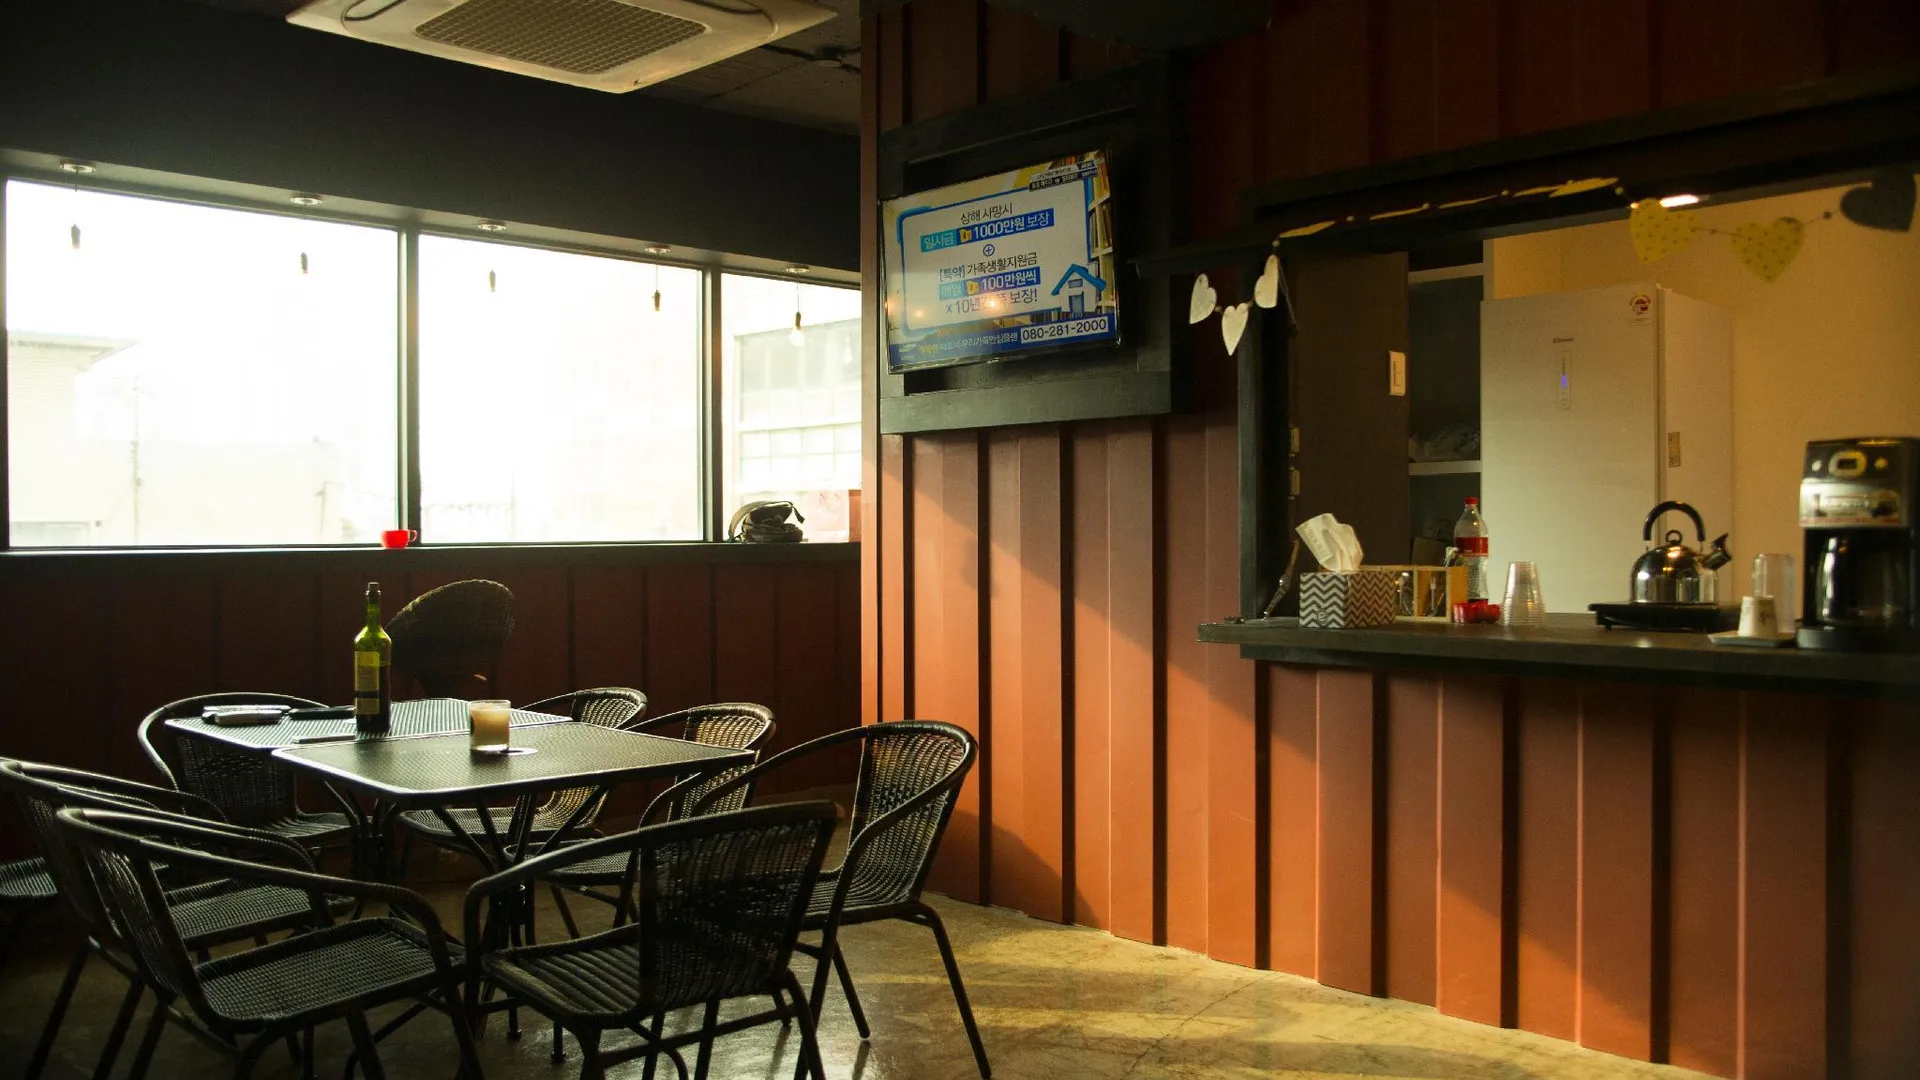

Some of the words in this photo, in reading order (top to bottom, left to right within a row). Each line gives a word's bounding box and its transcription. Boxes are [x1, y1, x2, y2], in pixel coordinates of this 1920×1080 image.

[960, 210, 981, 225] 상해
[982, 202, 1013, 219] 사망시
[924, 232, 956, 250] 일시금
[973, 216, 1025, 239] 1000만원
[1027, 211, 1050, 227] 보장
[967, 252, 1038, 274] 가족생활지원금
[981, 269, 1037, 290] 100만원씩
[1010, 288, 1038, 304] 보장!
[1022, 318, 1107, 340] 080-281-2000
